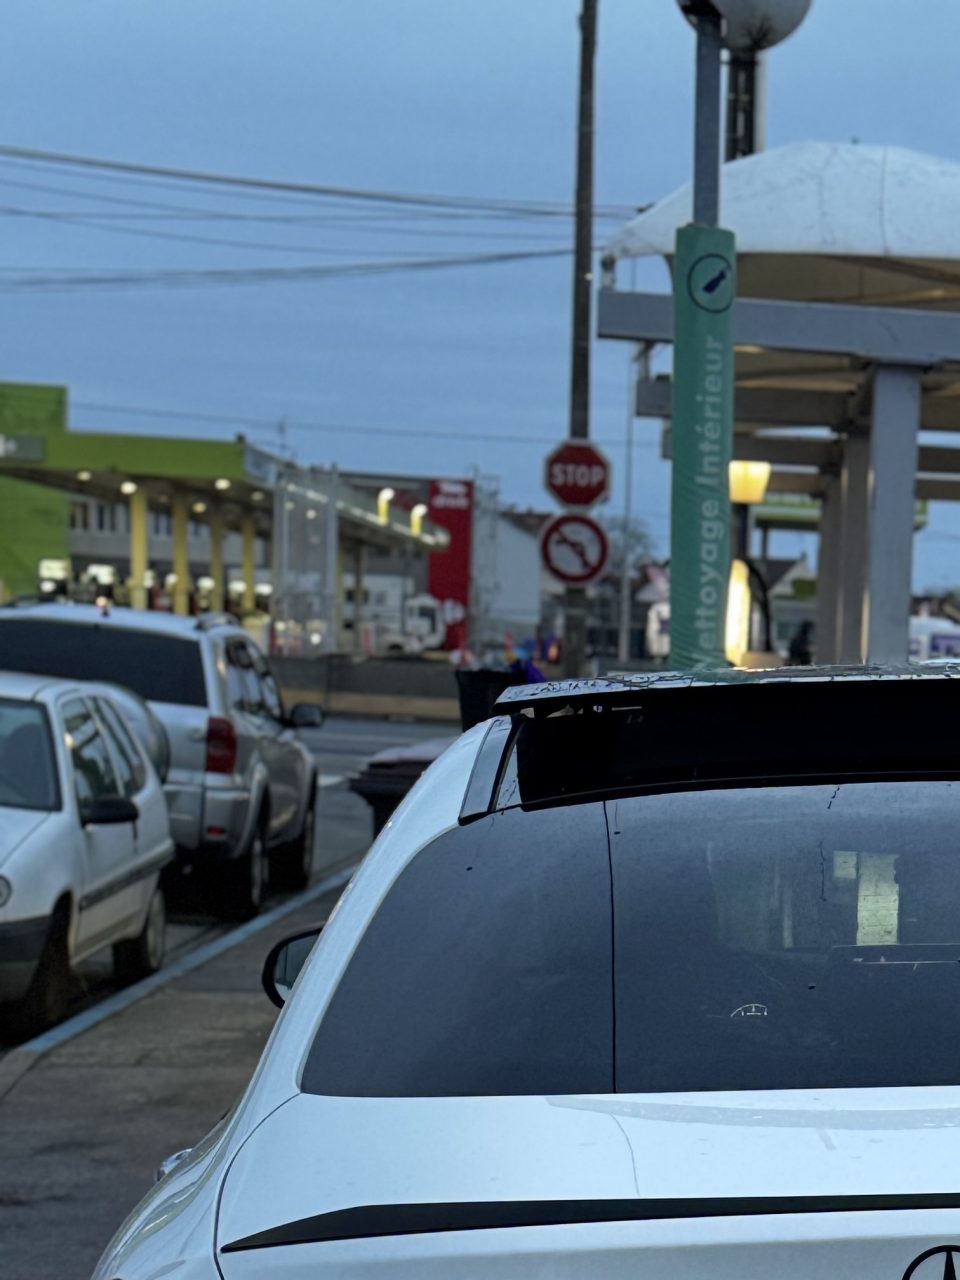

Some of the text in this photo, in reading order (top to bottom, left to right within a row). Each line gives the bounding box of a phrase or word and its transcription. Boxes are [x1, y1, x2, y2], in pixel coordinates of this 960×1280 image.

[552, 463, 604, 488] STOP
[694, 334, 724, 672] Nettoyage Intérieur
